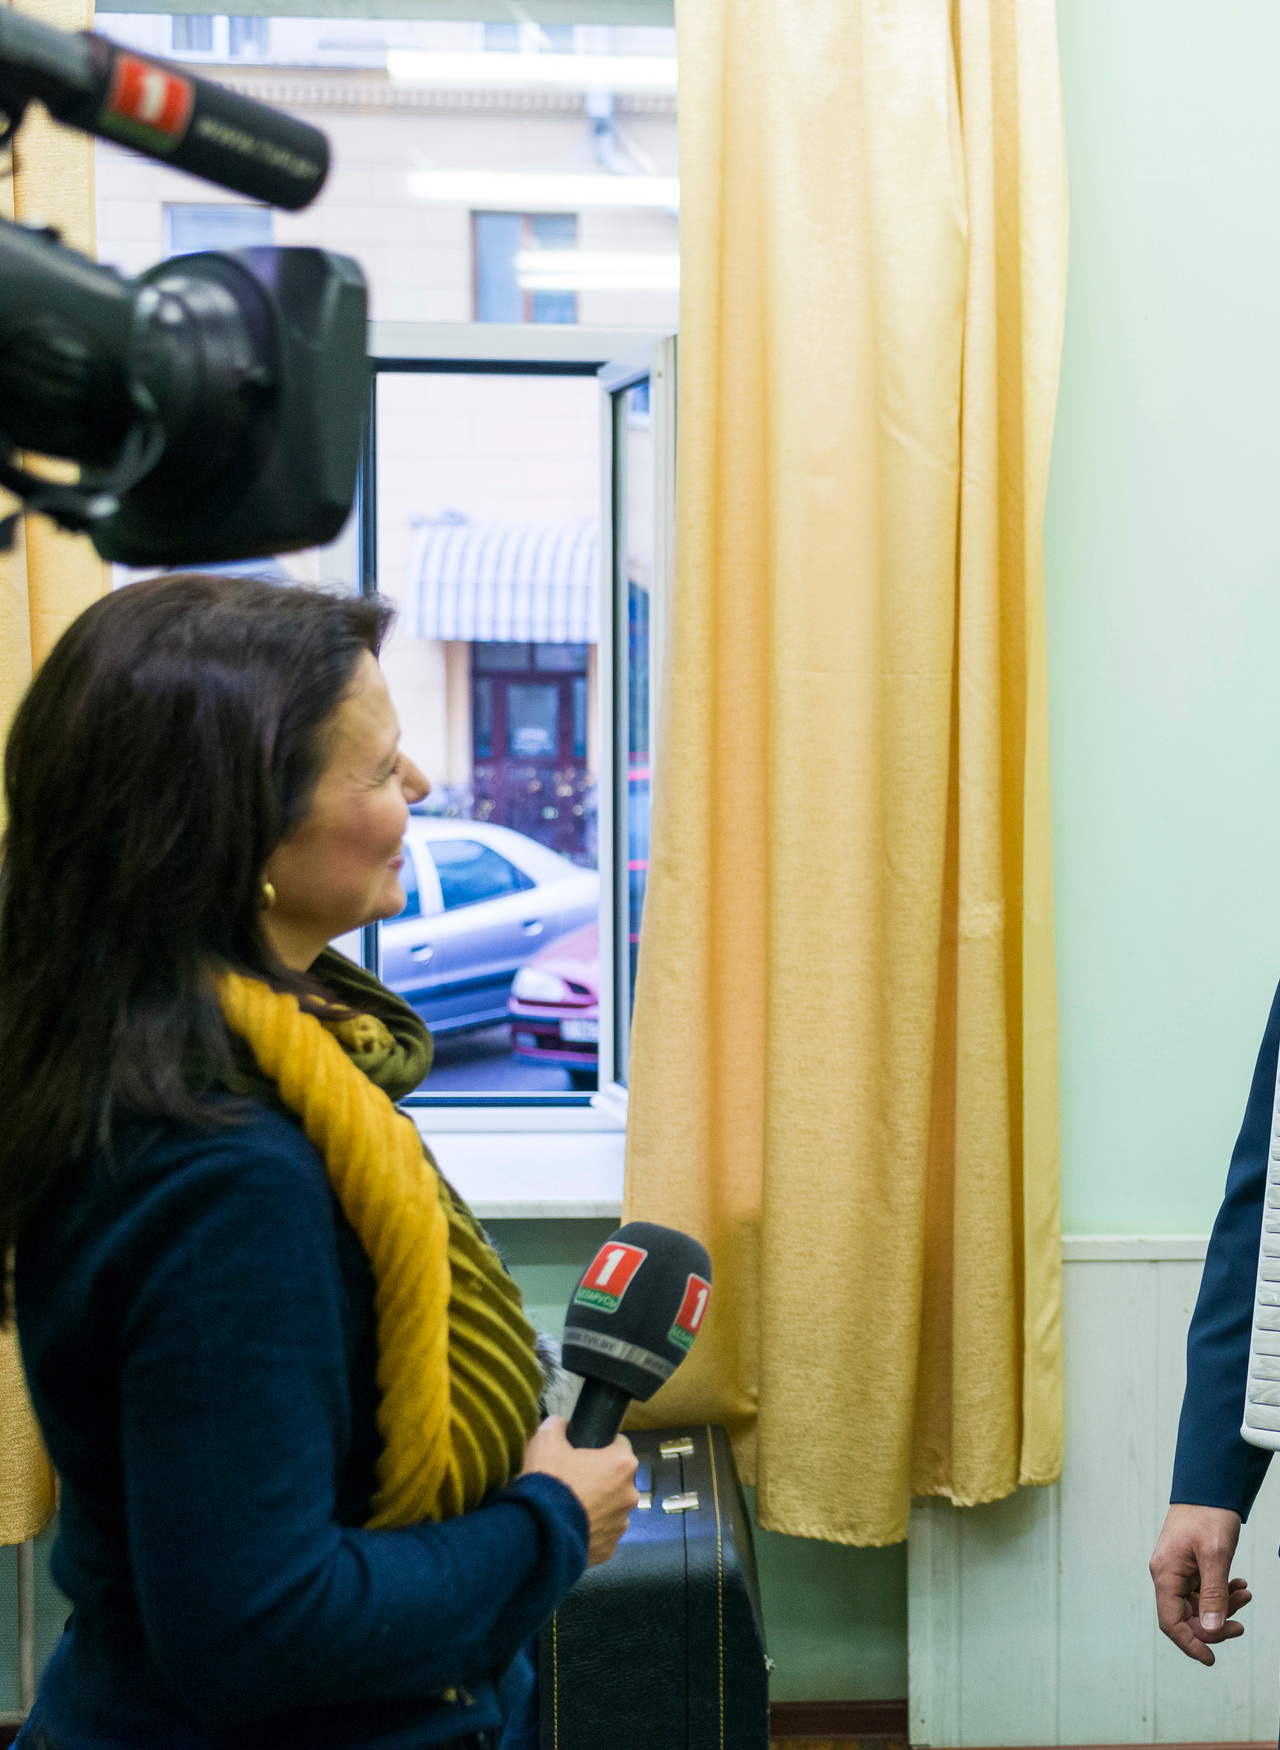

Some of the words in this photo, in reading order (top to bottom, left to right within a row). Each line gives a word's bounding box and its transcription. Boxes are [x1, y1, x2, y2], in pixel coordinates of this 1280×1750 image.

[138, 71, 168, 123] 1
[595, 1248, 627, 1286] 1
[690, 1288, 708, 1328] 1
